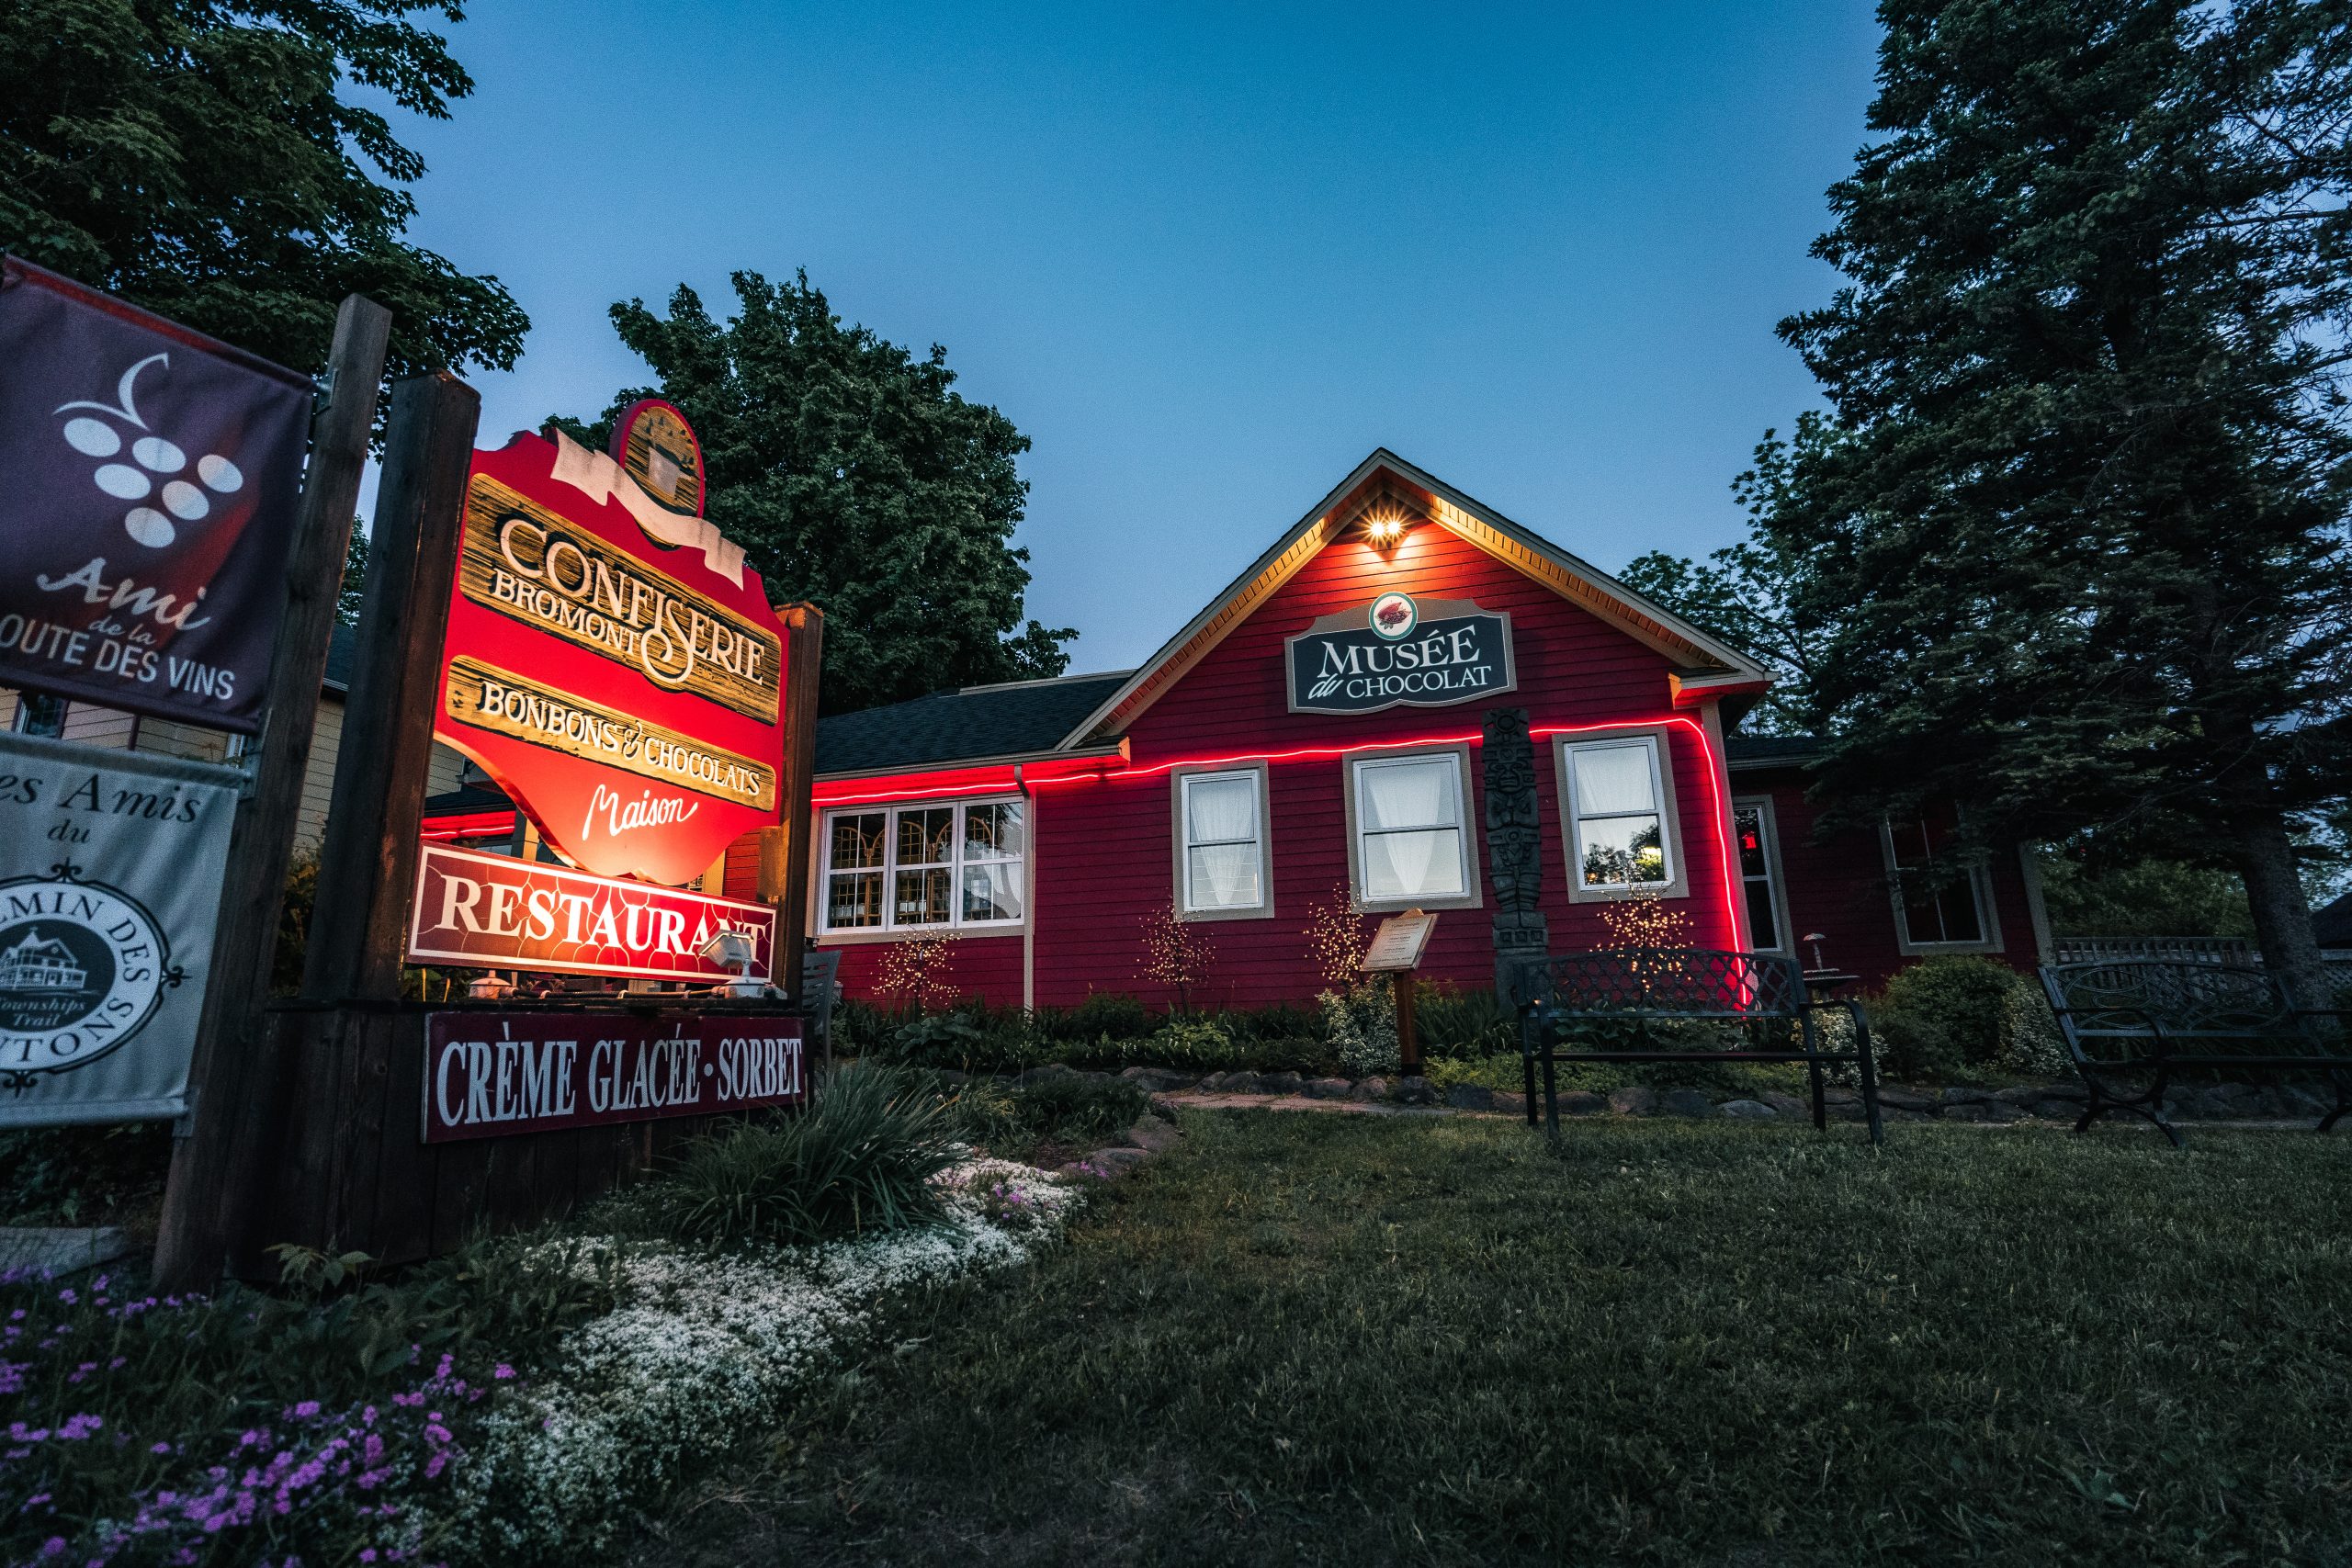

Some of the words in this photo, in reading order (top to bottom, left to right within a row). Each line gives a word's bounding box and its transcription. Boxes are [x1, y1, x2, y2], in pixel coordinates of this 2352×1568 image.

[37, 557, 212, 631] Ami
[491, 568, 643, 657] BROMONT
[499, 518, 765, 685] CONFISERIE
[88, 615, 127, 636] de
[131, 624, 158, 645] la
[1317, 625, 1481, 679] MUSÉE
[94, 642, 160, 683] DES
[168, 656, 236, 701] VINS
[1307, 672, 1345, 700] du
[1346, 665, 1492, 699] CHOCOLAT
[481, 680, 621, 753] BONBONS
[622, 719, 644, 761] &
[643, 739, 761, 796] CHOCOLATS
[59, 773, 201, 824] Amis
[582, 784, 698, 841] Maison
[48, 817, 91, 844] du
[107, 917, 151, 984] DES
[13, 1012, 62, 1028] Trail
[436, 1021, 578, 1128] CRÈME
[587, 1023, 703, 1113] GLACÉE
[717, 1038, 803, 1102] SORBET
